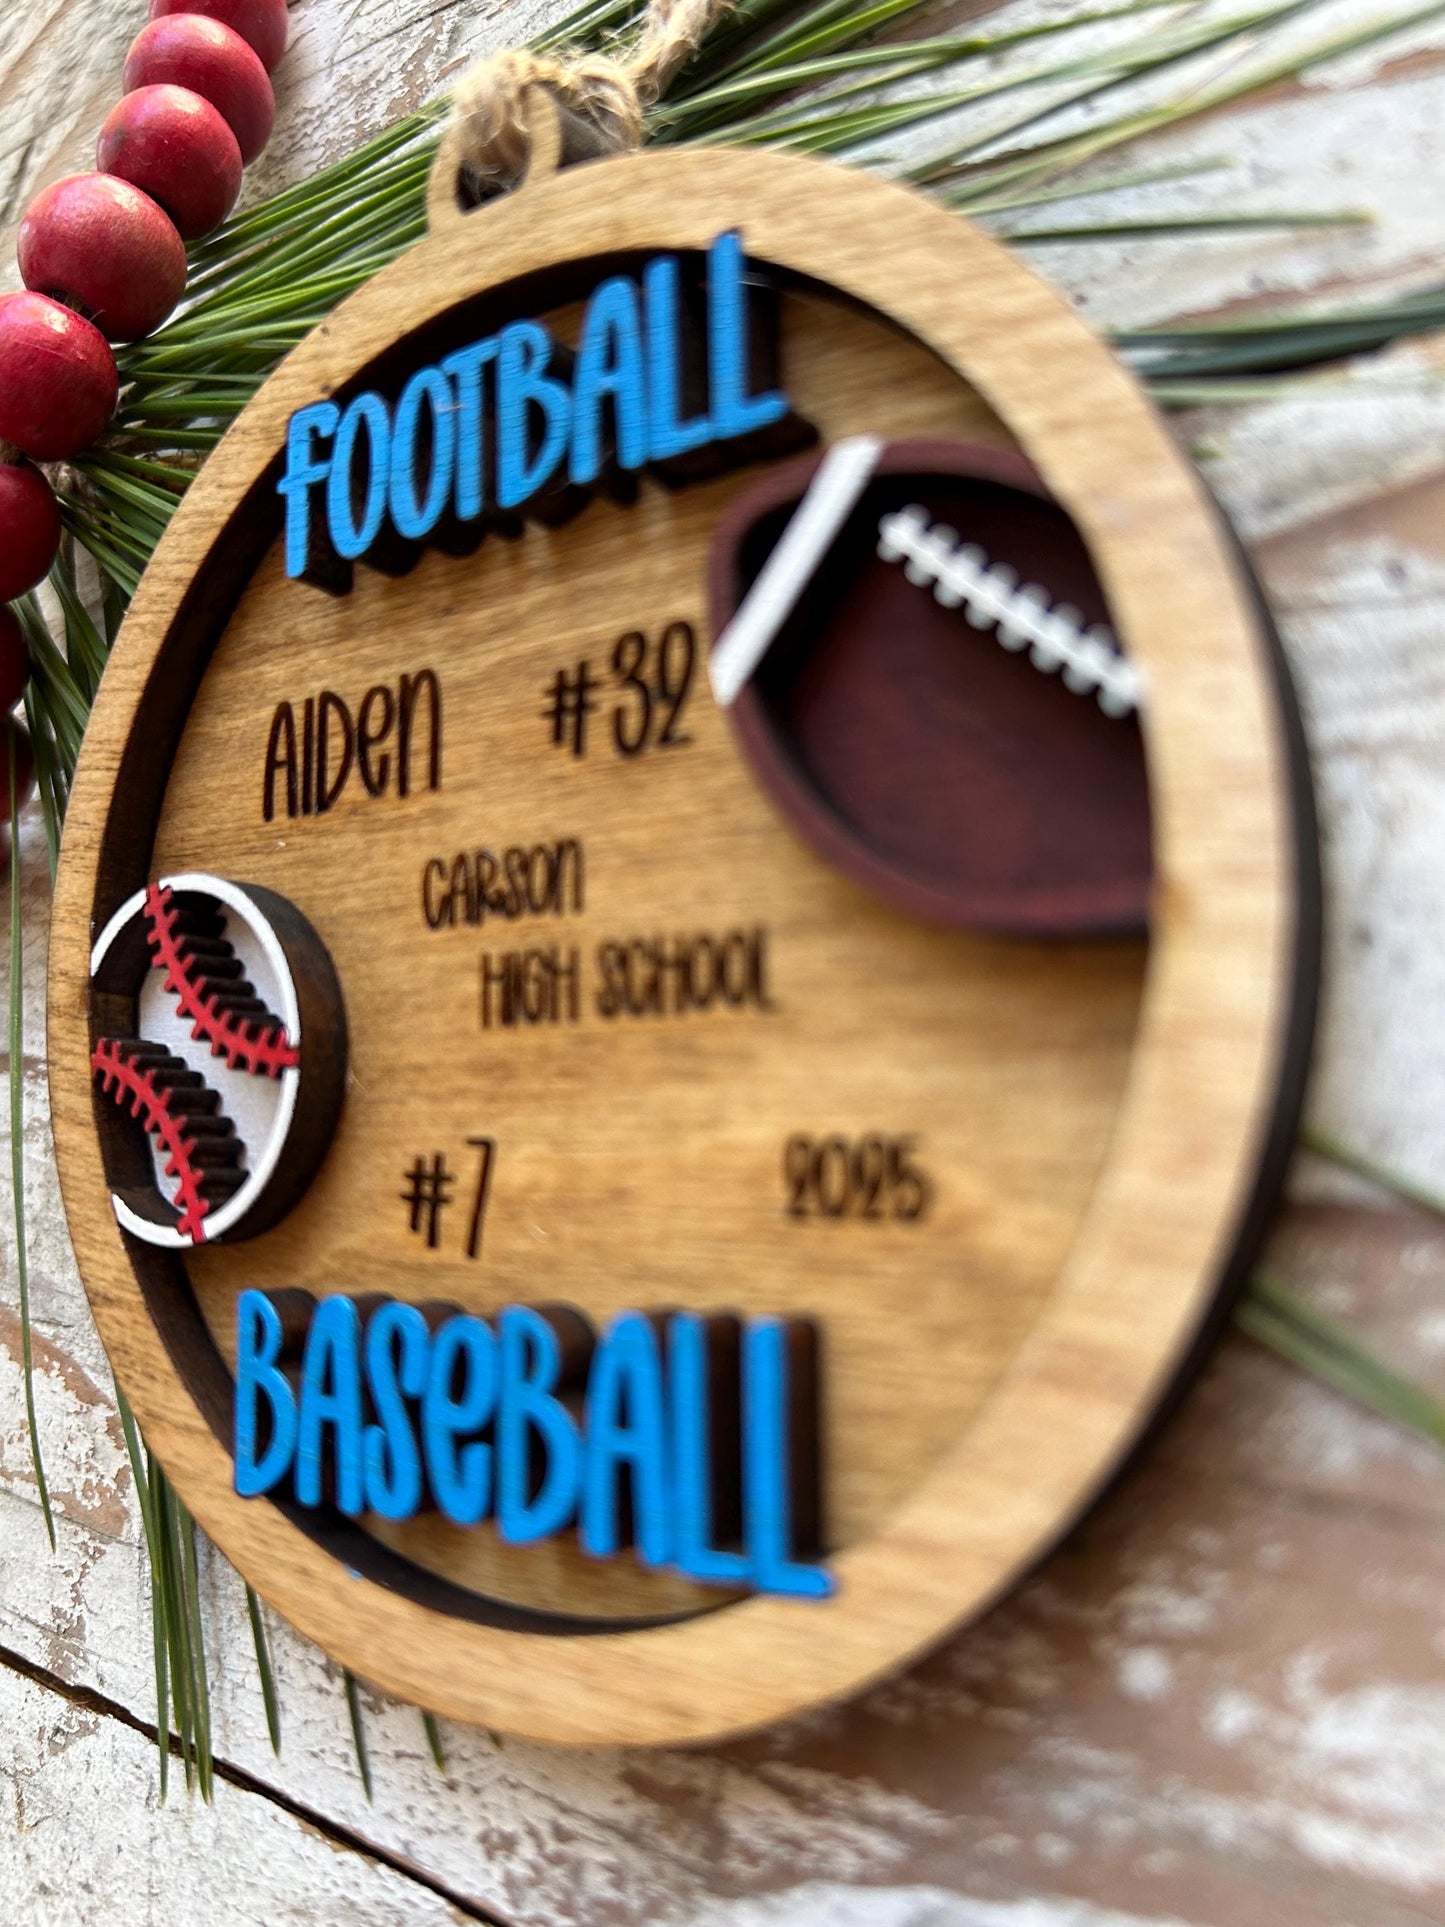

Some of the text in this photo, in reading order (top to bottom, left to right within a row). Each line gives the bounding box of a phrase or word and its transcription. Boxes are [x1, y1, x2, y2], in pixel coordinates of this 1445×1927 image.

[540, 620, 697, 759] #32
[480, 924, 777, 1030] HIGH SCHOOL
[399, 1131, 932, 1260] #7 2025
